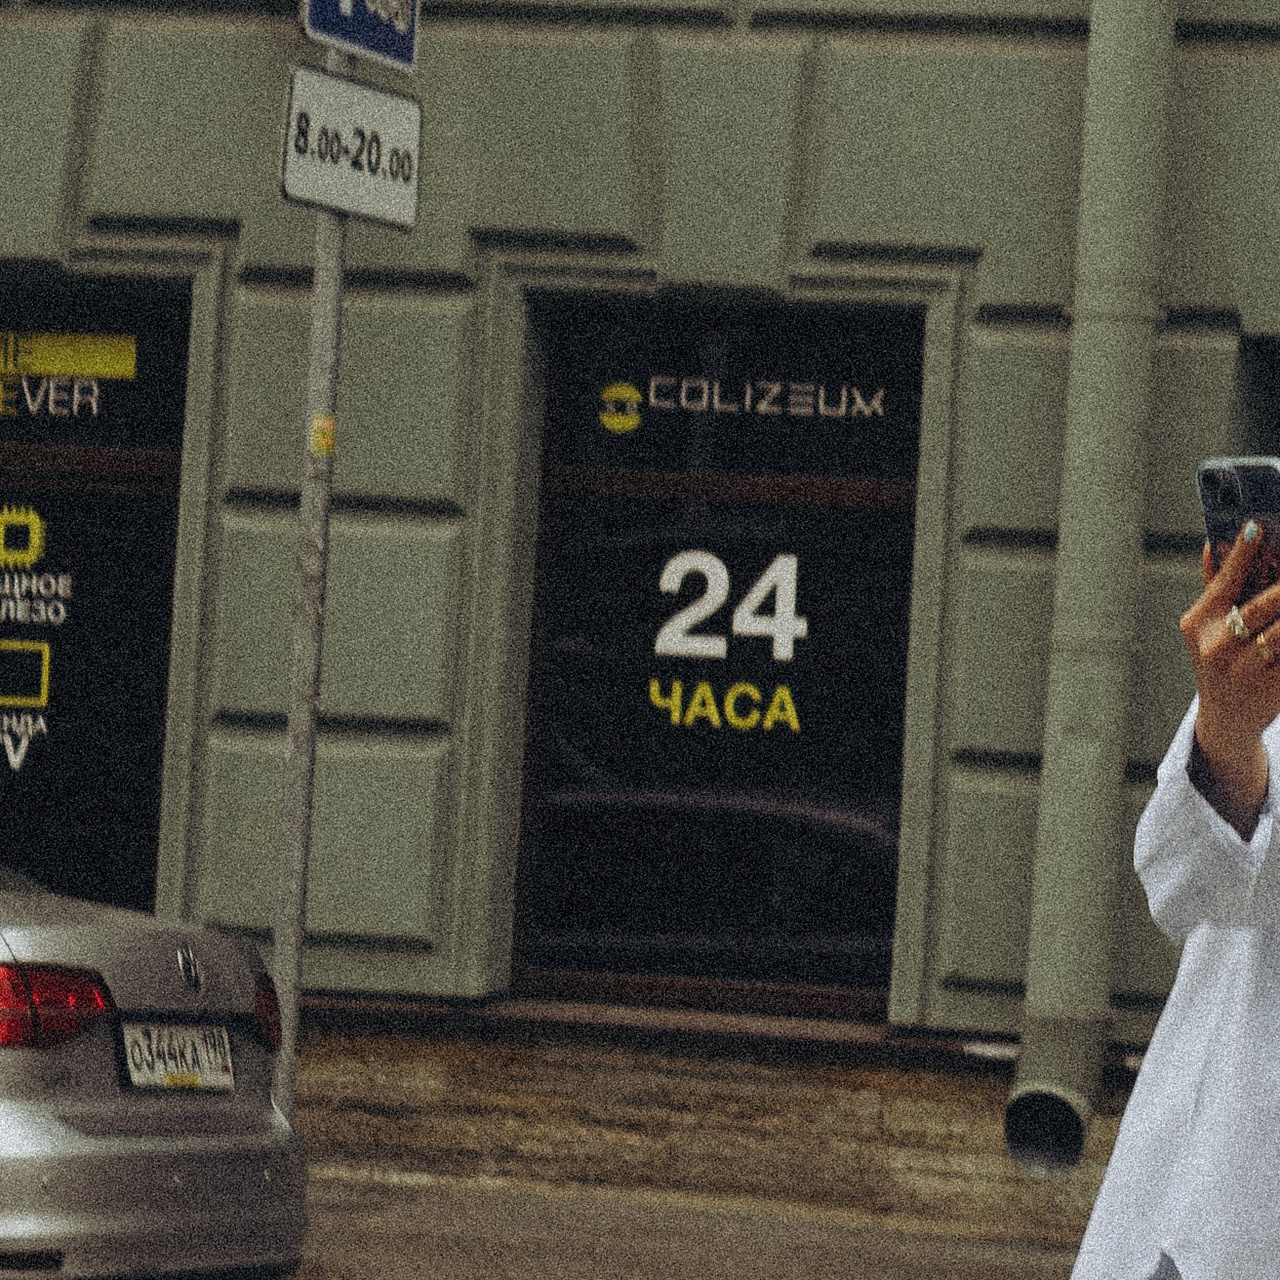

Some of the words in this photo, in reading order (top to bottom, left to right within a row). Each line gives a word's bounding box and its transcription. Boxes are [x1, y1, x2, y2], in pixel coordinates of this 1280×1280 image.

[294, 111, 412, 183] 8.00-20.00
[649, 376, 885, 418] COLIZEUM
[655, 550, 808, 660] 24
[650, 679, 801, 731] ЧАСА
